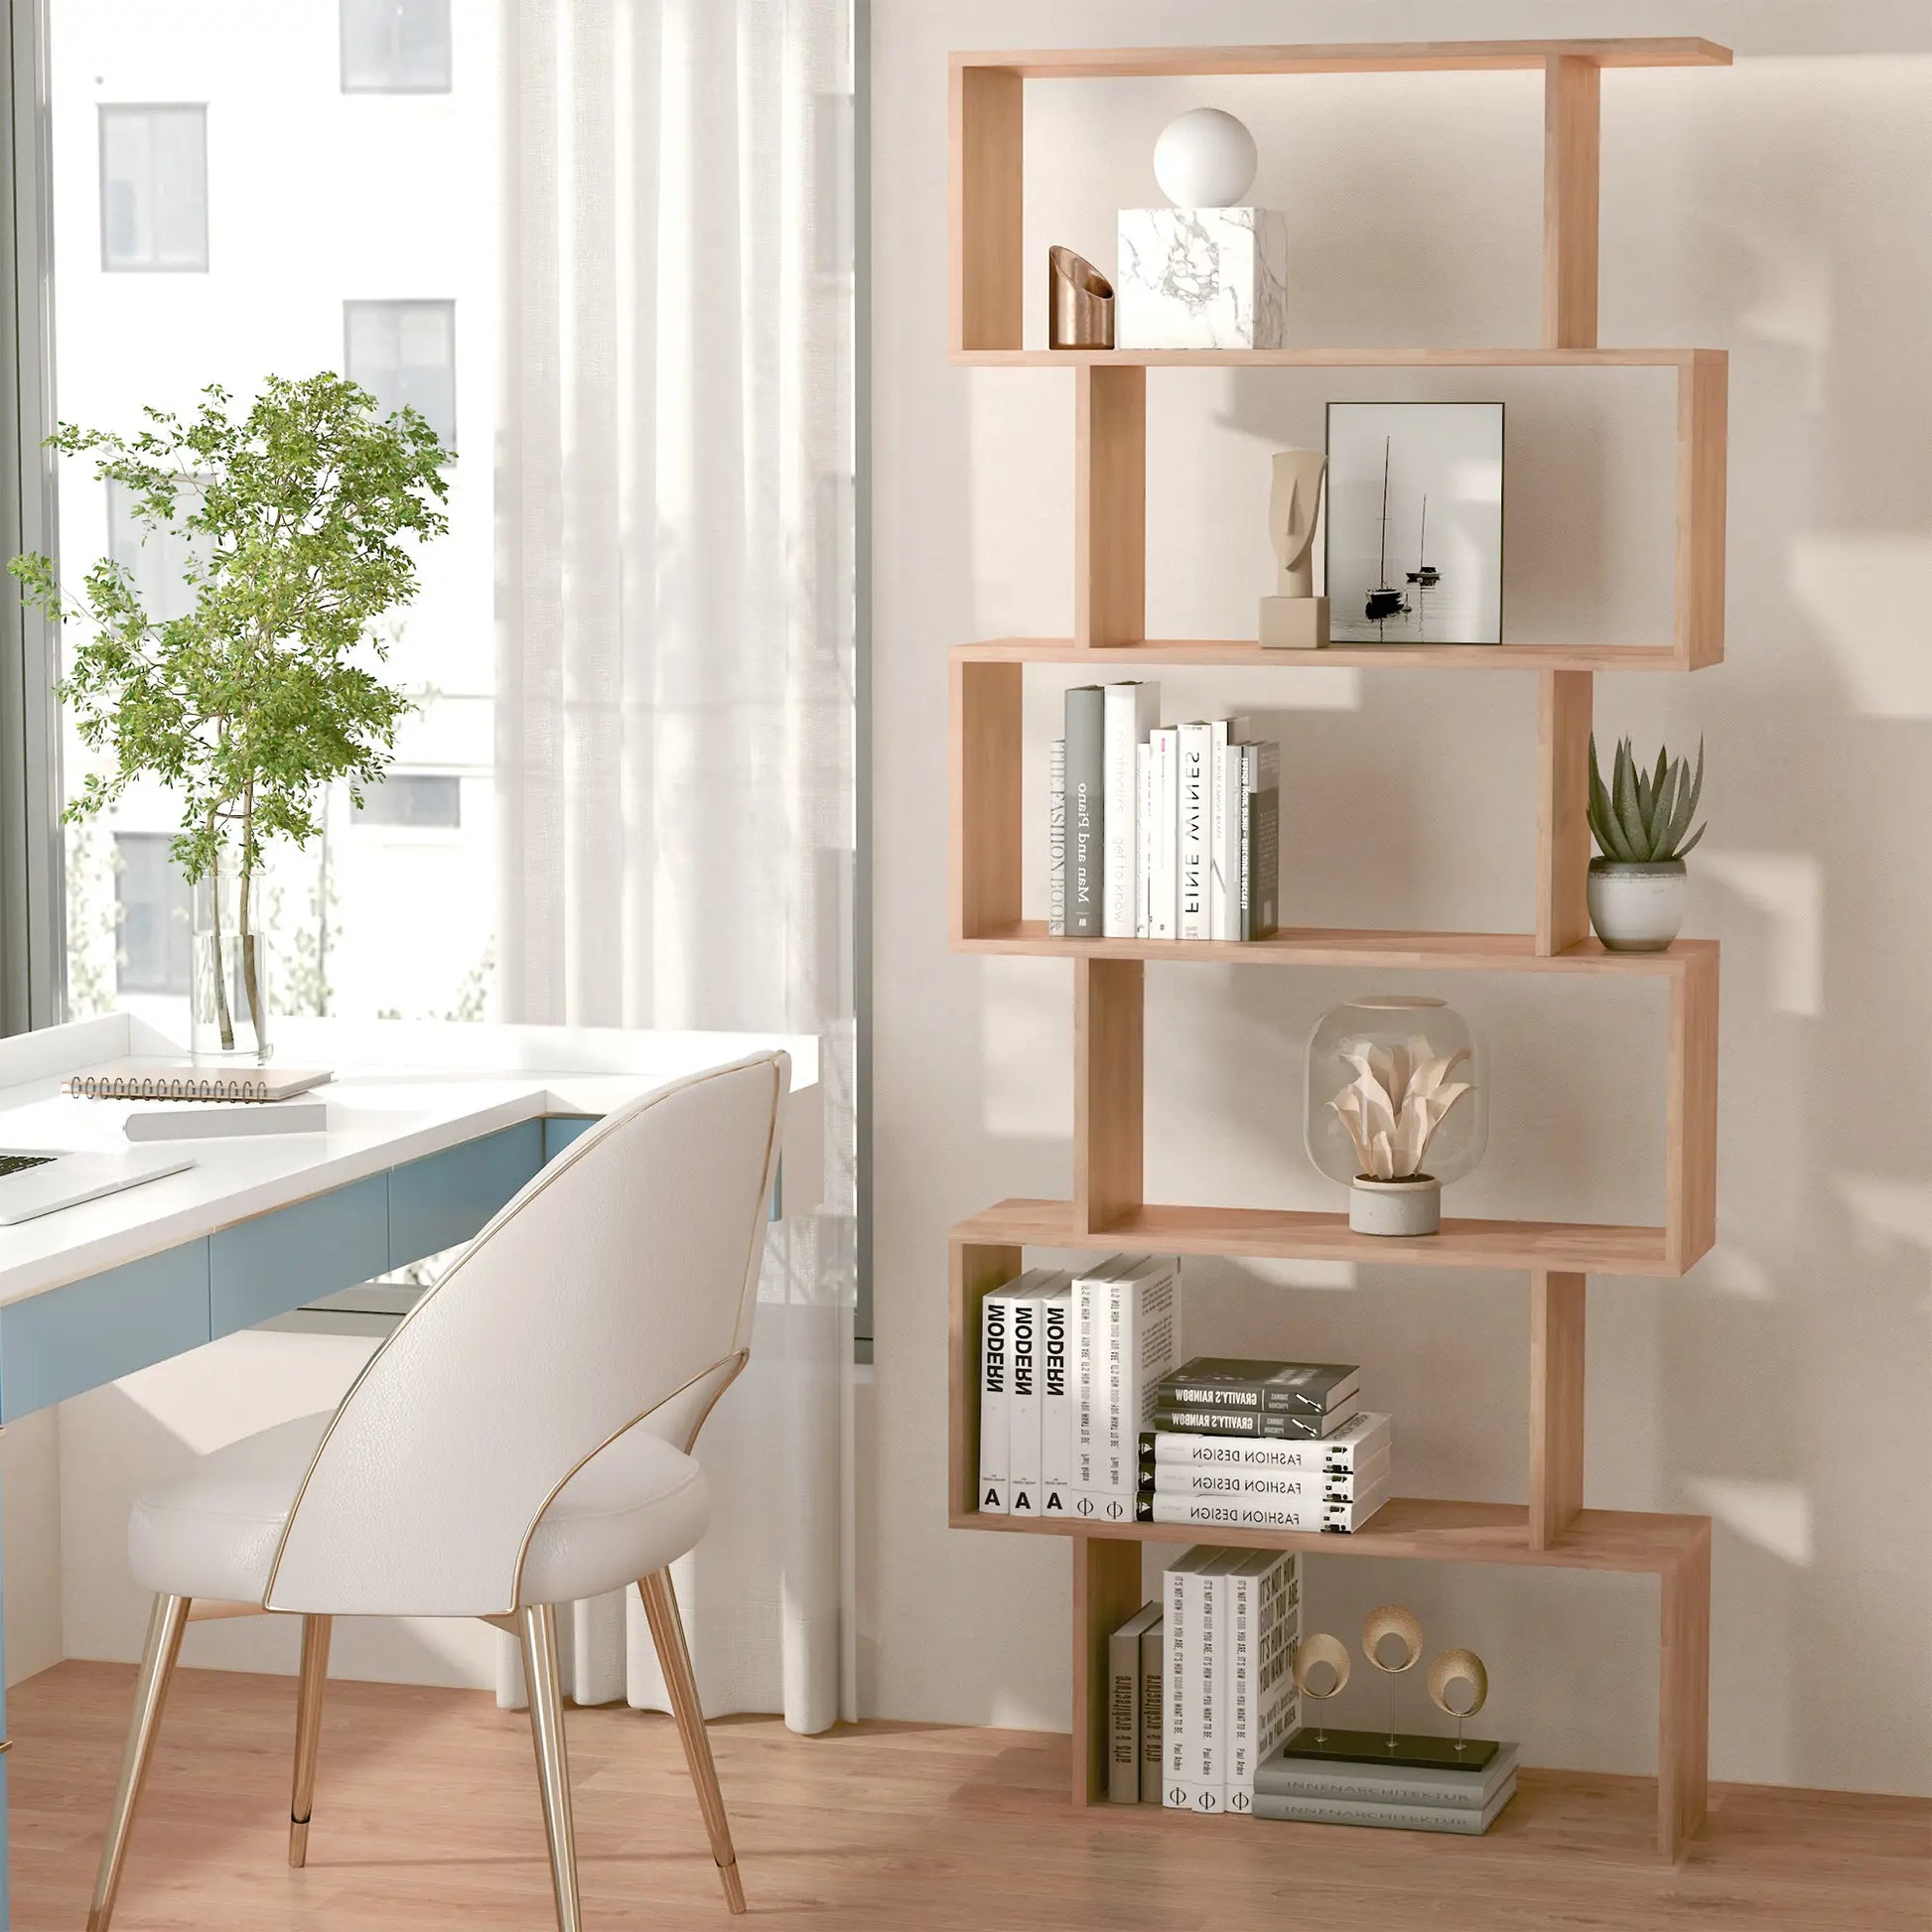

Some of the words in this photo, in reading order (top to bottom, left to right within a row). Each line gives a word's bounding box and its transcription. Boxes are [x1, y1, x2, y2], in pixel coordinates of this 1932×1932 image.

[1050, 790, 1065, 872] FASHION
[1112, 837, 1127, 859] get
[1115, 866, 1127, 880] to
[1114, 885, 1127, 922] know
[1112, 1676, 1132, 1730] architecture
[1144, 1675, 1161, 1729] architecture
[1113, 1745, 1132, 1763] arts
[1145, 1744, 1161, 1762] arts
[1287, 1781, 1469, 1802] INNENARCHITEKTUR
[1285, 1805, 1467, 1826] INNENARCHITEKTUR
